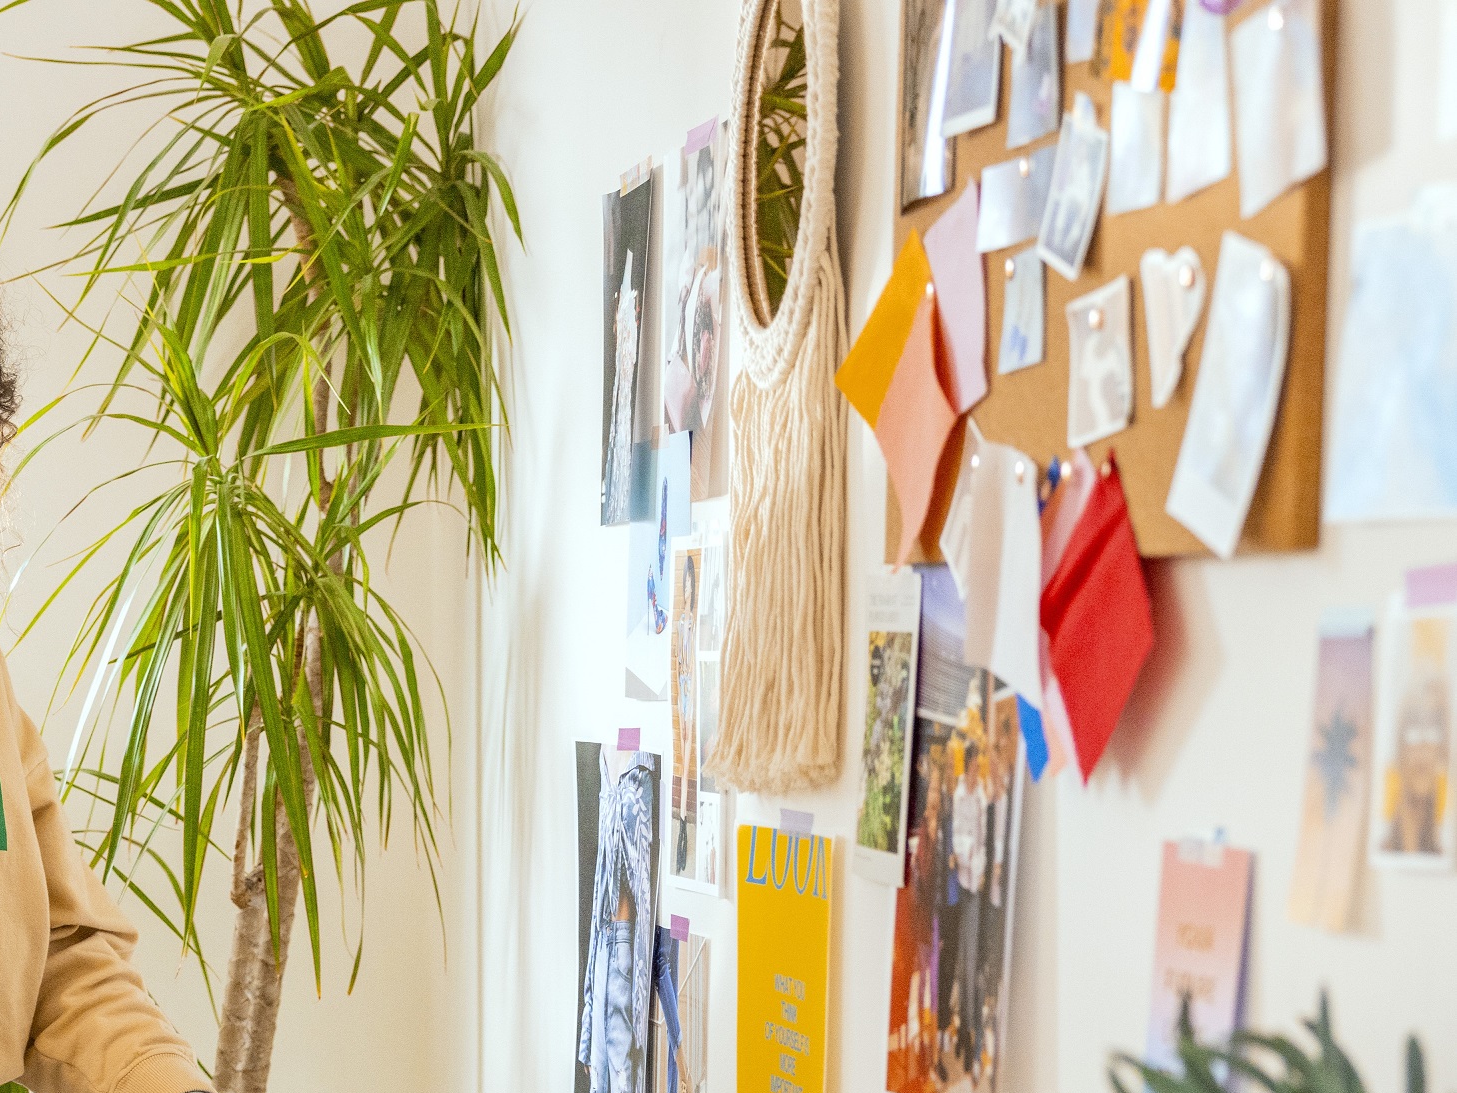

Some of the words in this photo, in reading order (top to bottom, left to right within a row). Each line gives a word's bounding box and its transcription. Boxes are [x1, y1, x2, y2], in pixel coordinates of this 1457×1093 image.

[774, 973, 792, 995] WHAT
[792, 978, 805, 1001] YOU
[780, 1000, 797, 1024] THINK
[764, 1021, 774, 1040] OF
[779, 1053, 796, 1077] MORE
